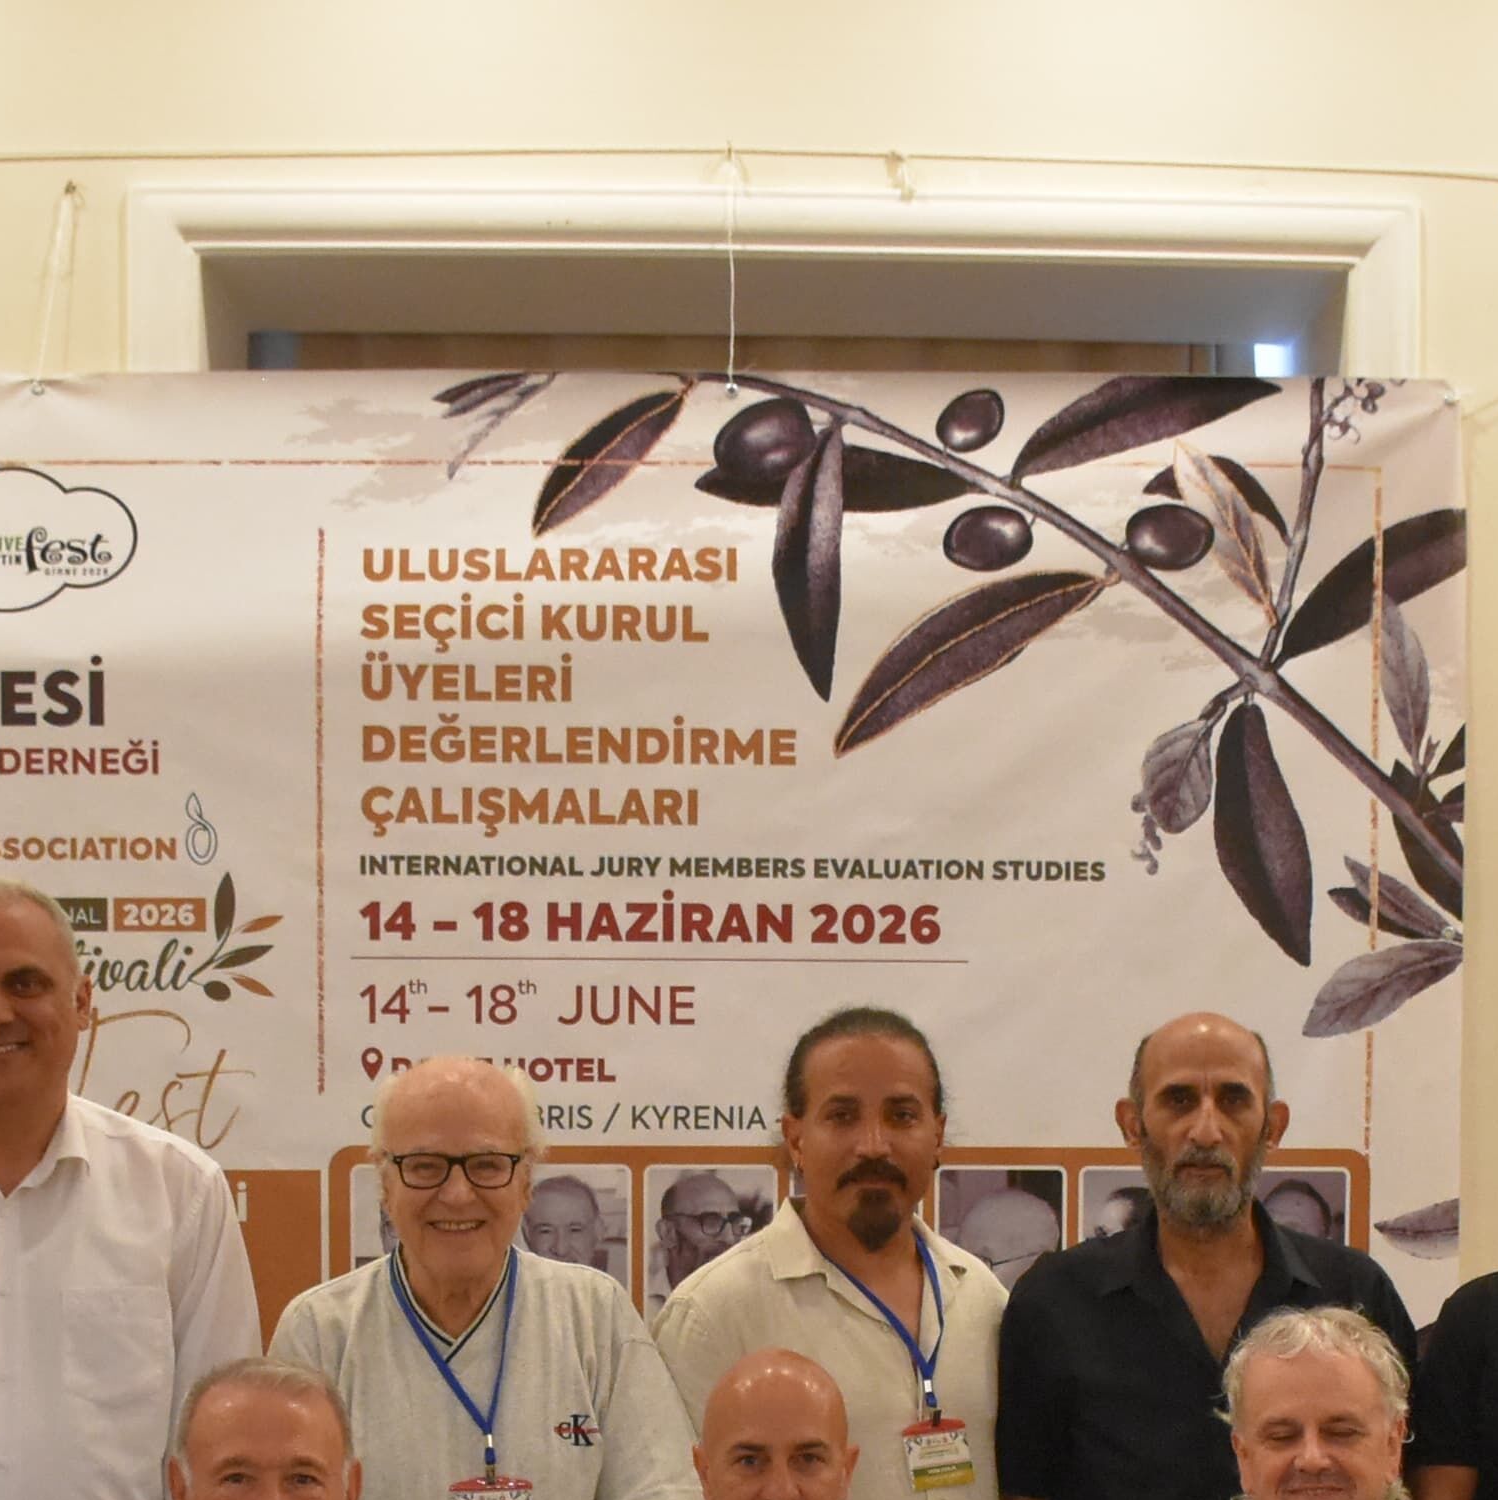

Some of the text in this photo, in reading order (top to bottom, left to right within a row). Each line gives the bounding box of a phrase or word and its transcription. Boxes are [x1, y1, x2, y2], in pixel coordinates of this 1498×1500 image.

[23, 526, 113, 576] fest
[362, 546, 738, 583] ULUSLARARASI
[360, 592, 710, 654] SEÇİCİ KURUL
[360, 651, 573, 703] ÜYELERİ
[361, 712, 798, 767] DEĞERLENDİRME
[360, 786, 699, 838] ÇALIŞMALARI
[359, 854, 1106, 882] INTERNATIONAL JURY MEMBERS EVALUATION STUDIES
[122, 904, 196, 927] 2026
[359, 889, 941, 945] 14 18 HAZİRAN 2026
[359, 978, 696, 1026] 14th 18th JUNE
[631, 1103, 767, 1131] KYRENIA
